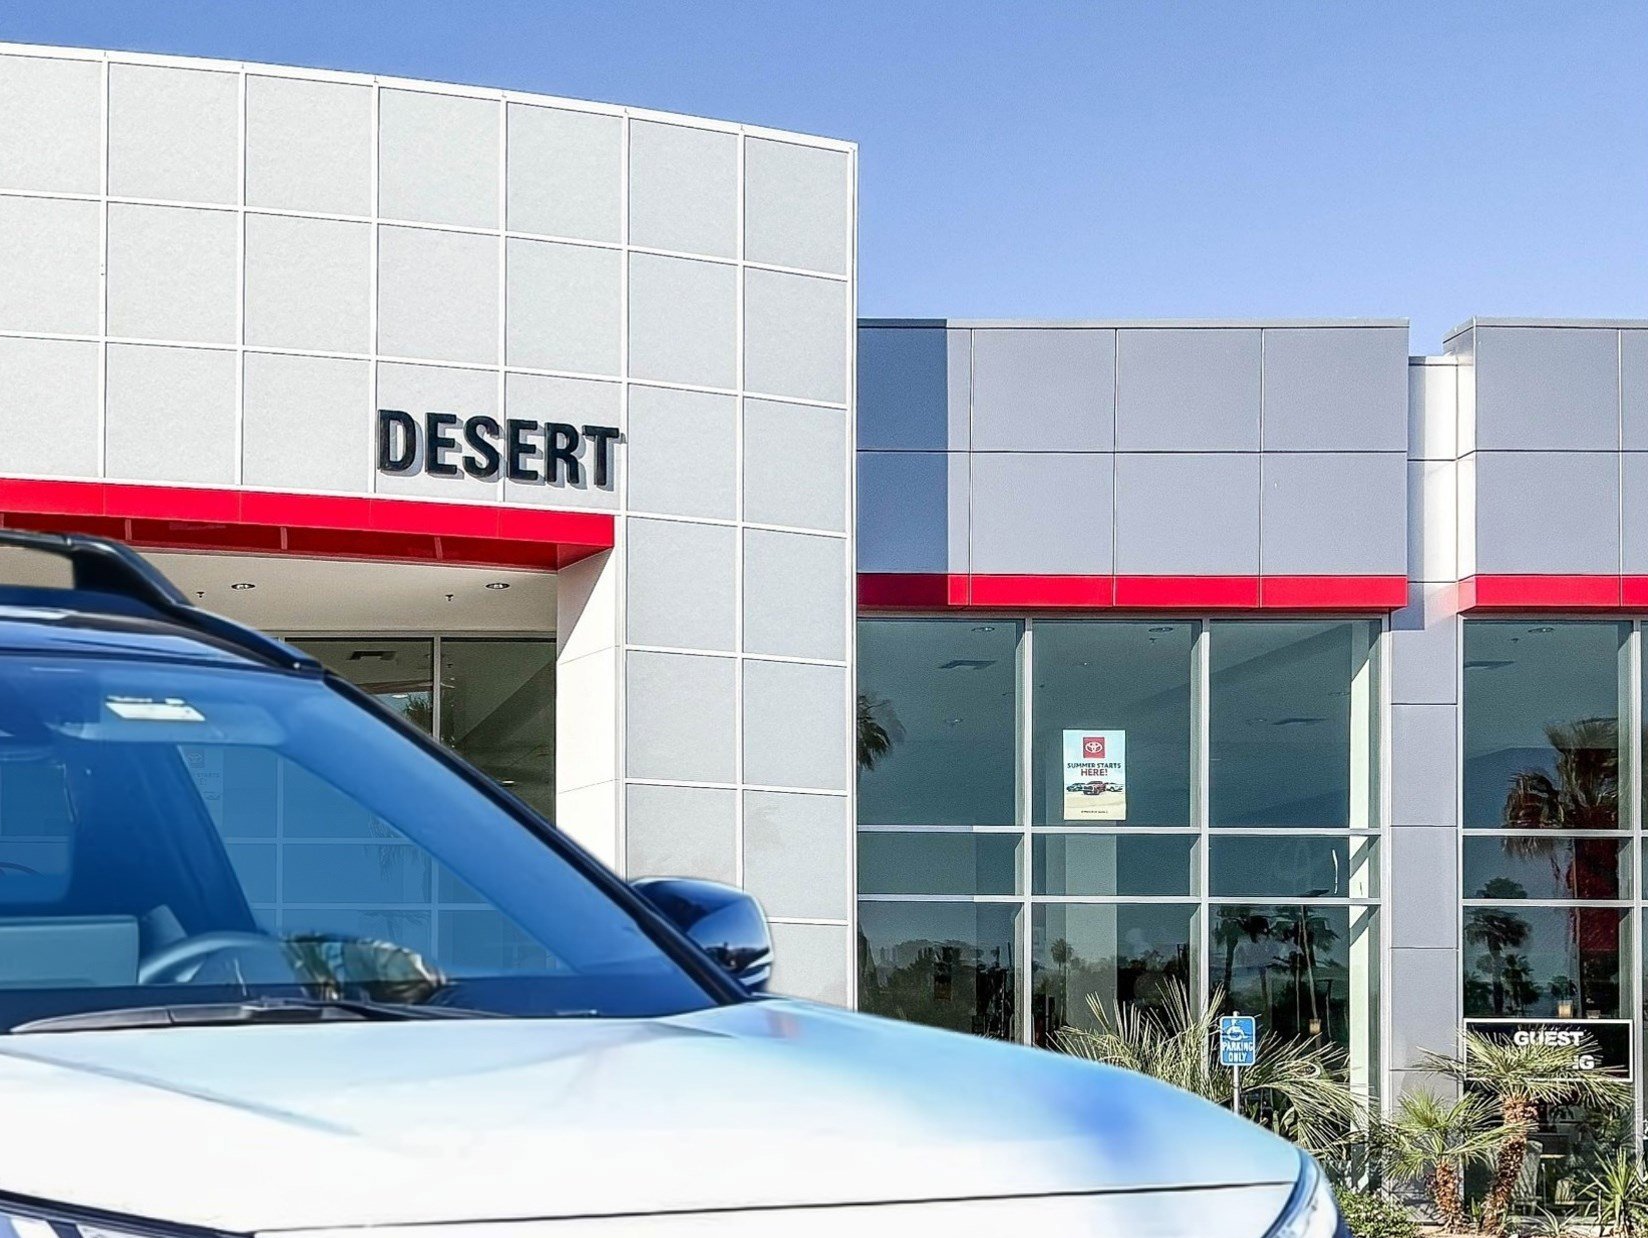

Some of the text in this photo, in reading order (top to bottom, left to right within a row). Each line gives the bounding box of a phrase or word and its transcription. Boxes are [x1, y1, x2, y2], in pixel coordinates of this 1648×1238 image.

[377, 409, 620, 487] DESERT
[1080, 768, 1108, 777] HERE!
[1513, 1030, 1584, 1047] GUEST
[1222, 1041, 1253, 1052] PARKING
[1228, 1051, 1248, 1063] ONLY
